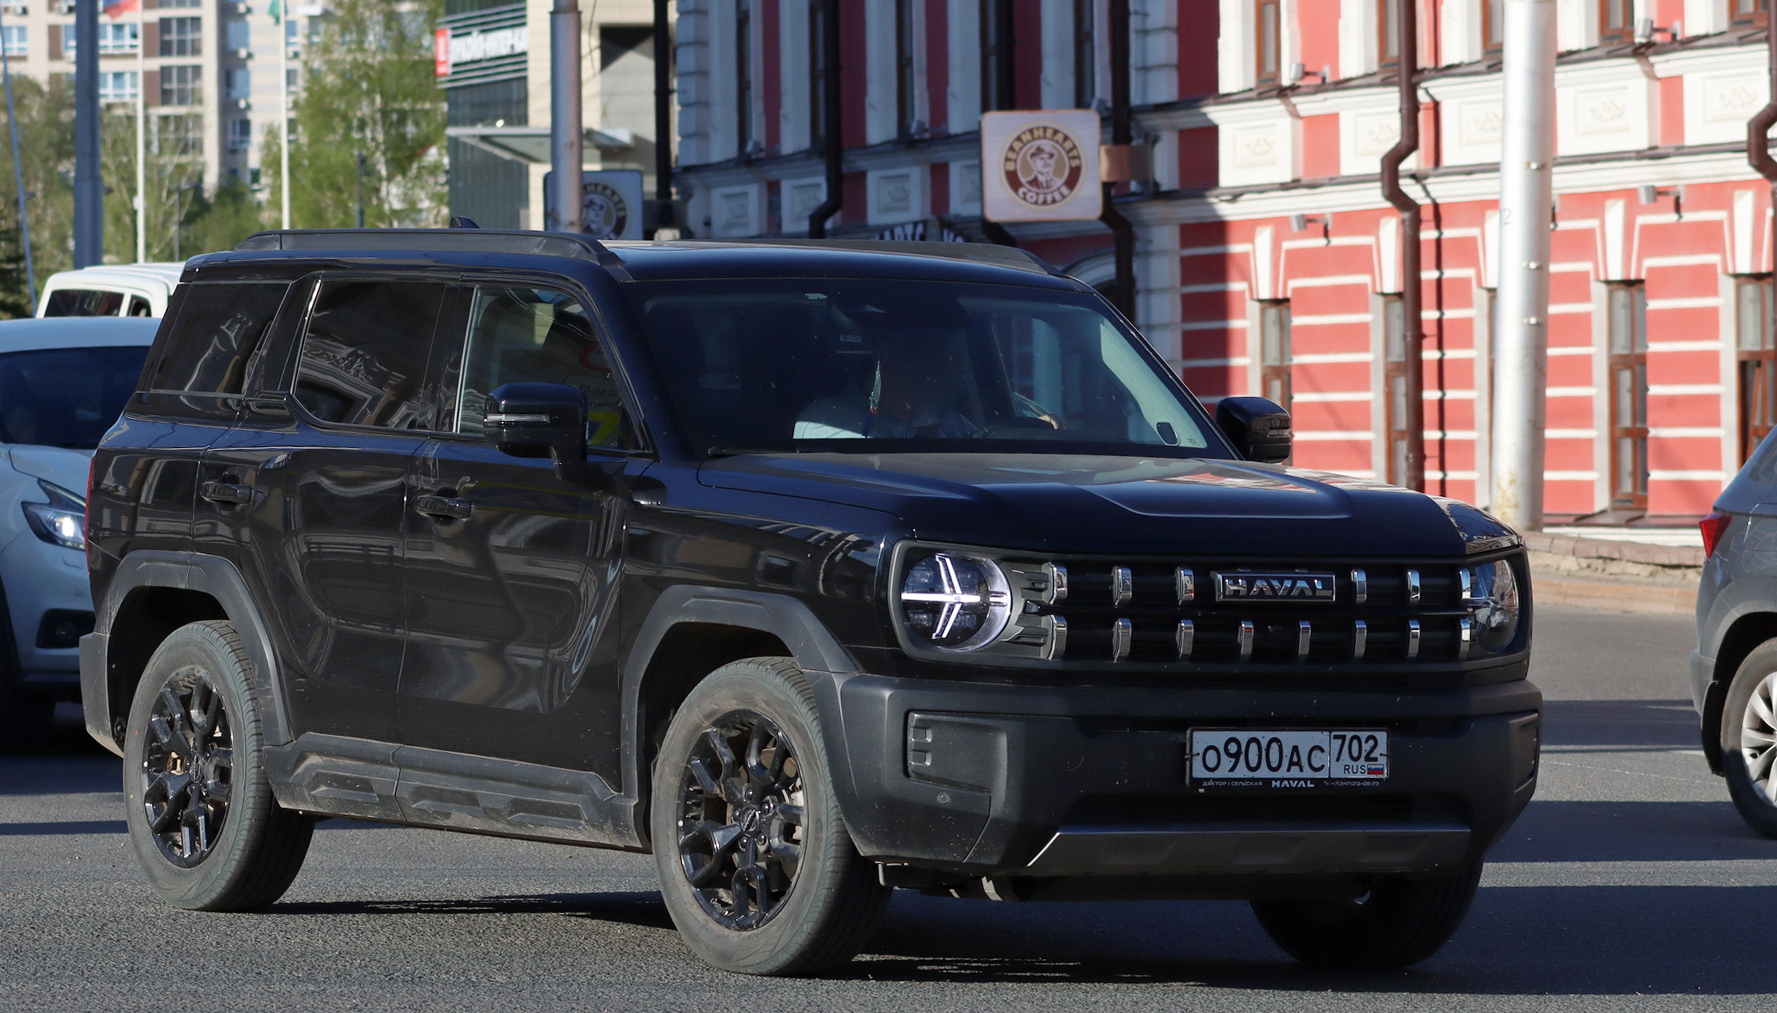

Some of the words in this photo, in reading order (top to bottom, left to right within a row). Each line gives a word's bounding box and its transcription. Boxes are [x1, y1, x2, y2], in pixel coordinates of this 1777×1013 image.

[1004, 127, 1081, 171] BEANHEARTS
[1018, 186, 1070, 205] COFFEE
[1225, 579, 1332, 596] HAVAL
[1333, 734, 1378, 763] 702
[1343, 764, 1367, 774] RUS
[1271, 780, 1315, 788] HAVAL
